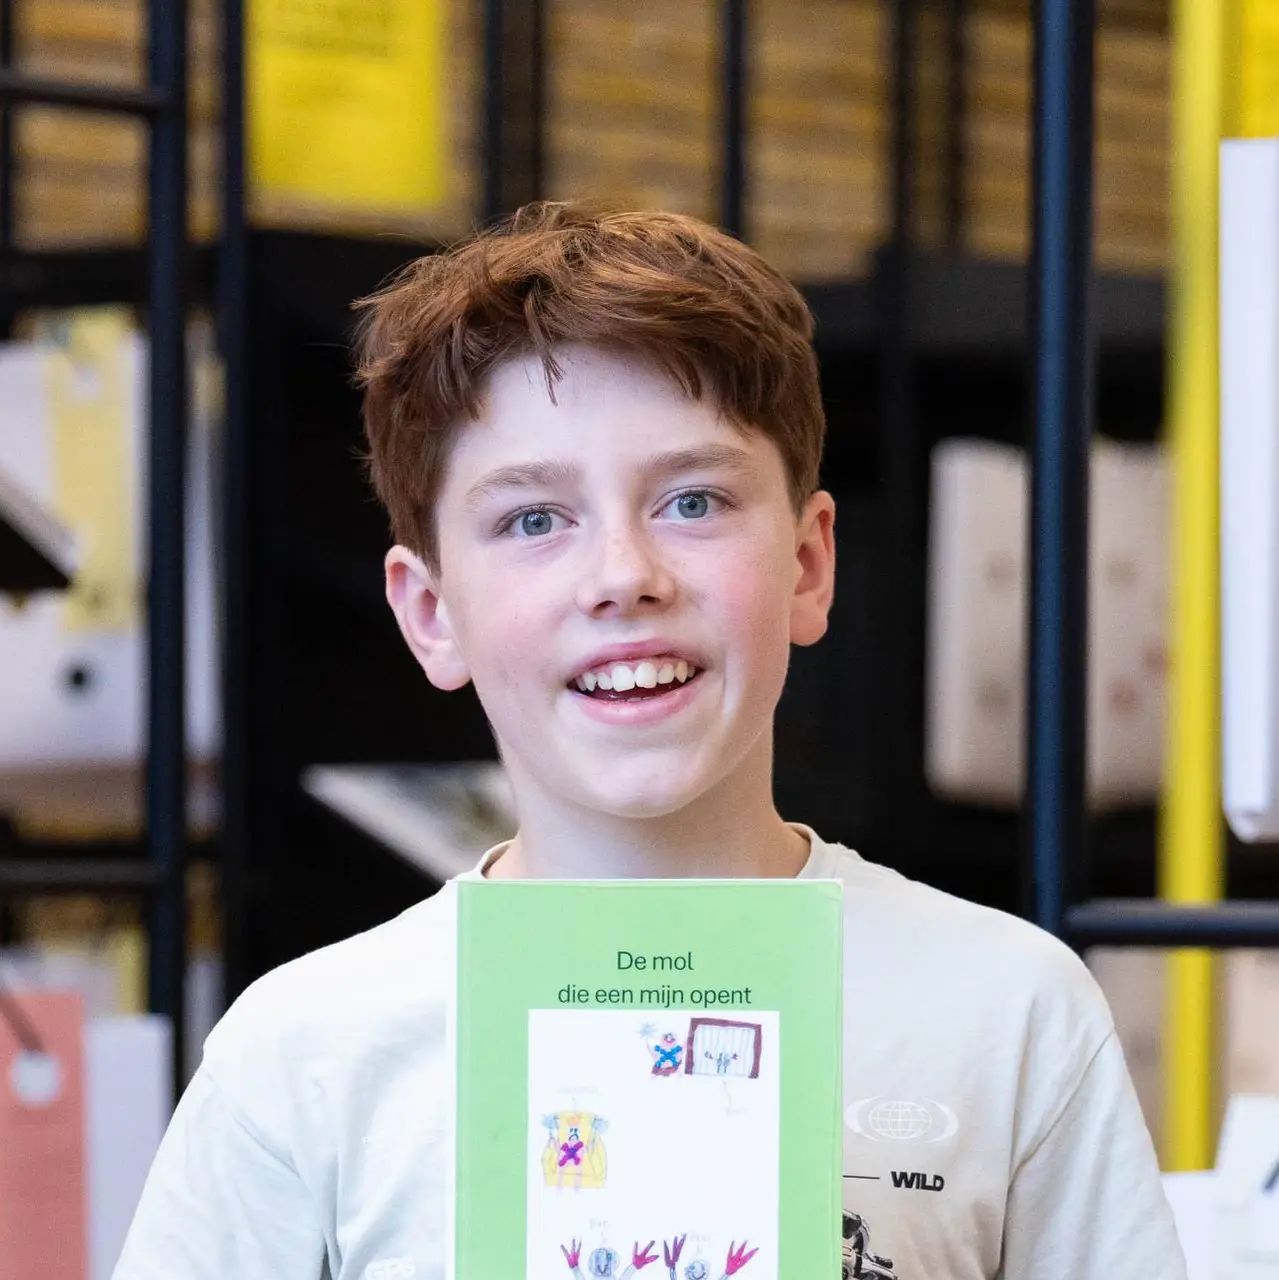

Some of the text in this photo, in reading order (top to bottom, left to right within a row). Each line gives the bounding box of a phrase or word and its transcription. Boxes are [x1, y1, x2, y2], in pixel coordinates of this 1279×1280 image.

[617, 951, 694, 971] De mol
[557, 984, 752, 1008] die een mijn opent
[890, 1171, 945, 1192] WILD
